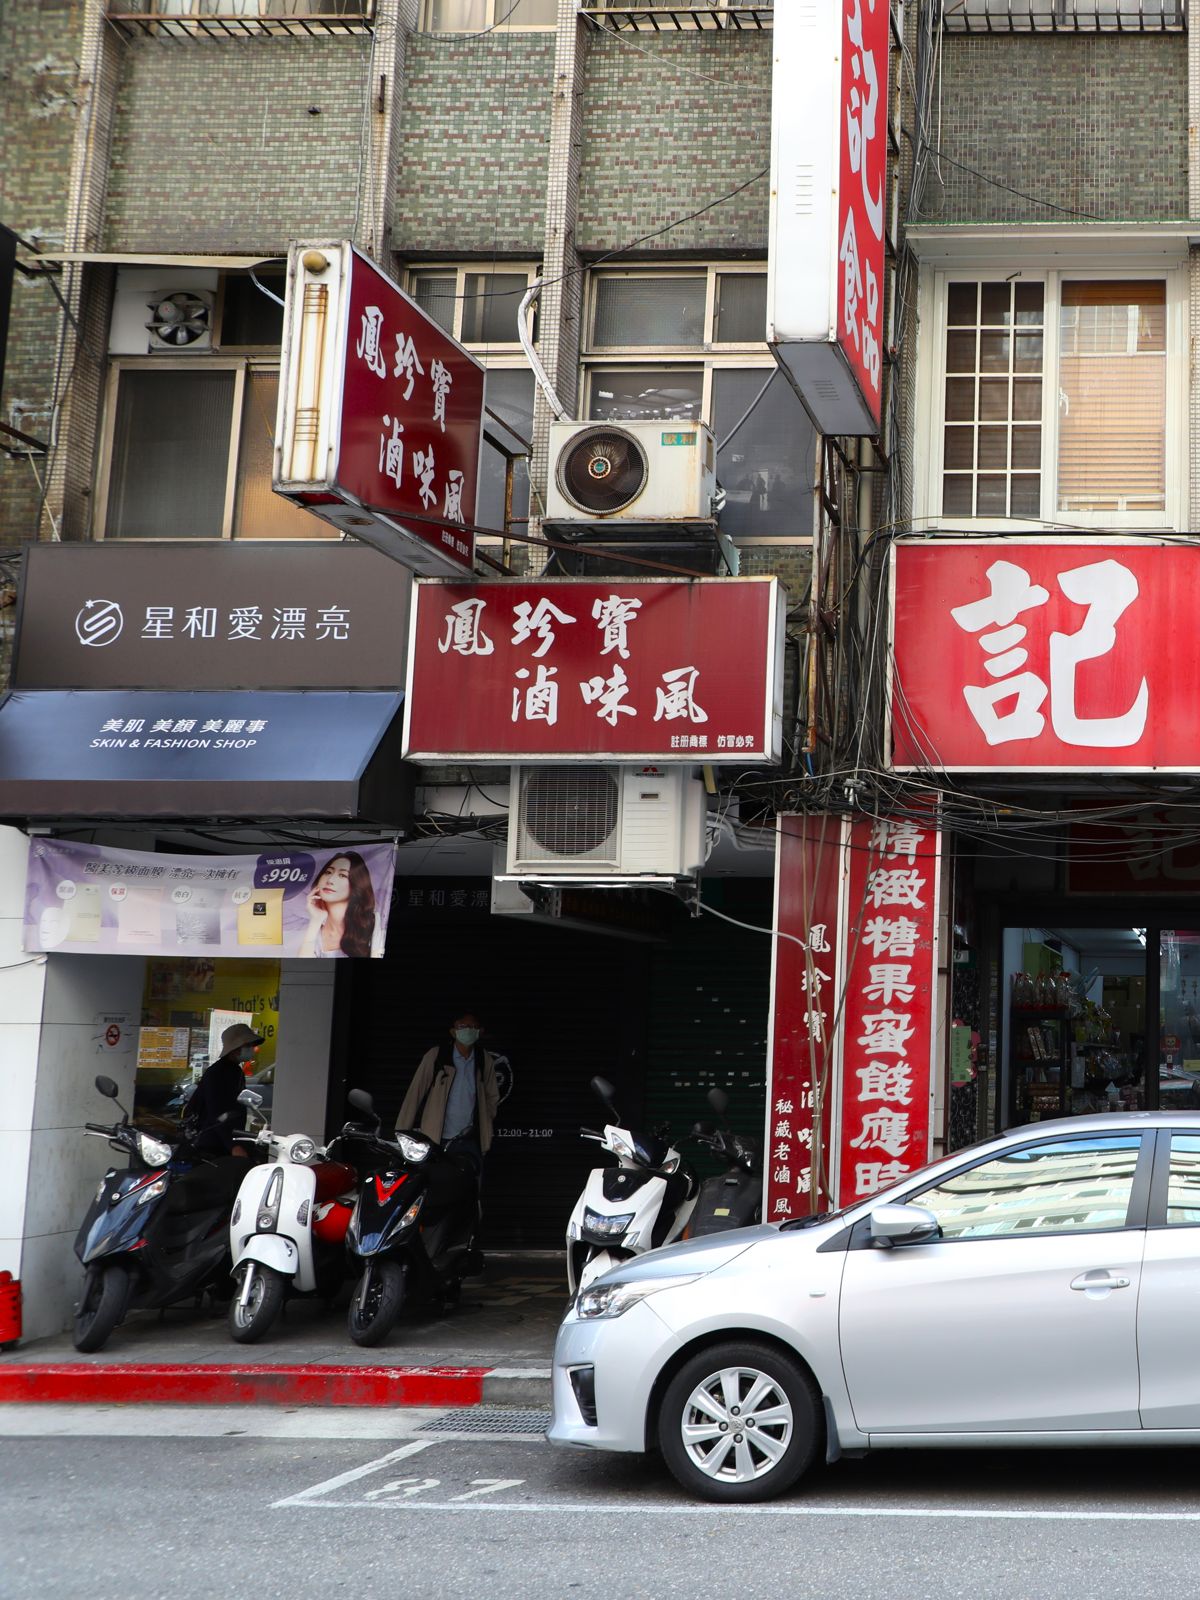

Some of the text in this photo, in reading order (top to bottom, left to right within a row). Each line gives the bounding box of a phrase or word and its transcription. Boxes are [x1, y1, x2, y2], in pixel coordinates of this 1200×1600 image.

[356, 305, 453, 433] 鳳珍寶
[378, 414, 466, 532] 滷味風
[140, 605, 351, 641] 星和愛漂亮
[437, 594, 643, 660] 鳳珍寶
[511, 663, 709, 727] 滷味風
[89, 738, 257, 749] SKIN & FASHION SHOP
[99, 718, 268, 734] 美肌 美顏 美麗事
[717, 735, 754, 748] 仿冒必究
[773, 1098, 794, 1184] 秘藏老滷
[363, 1478, 527, 1501] 87
